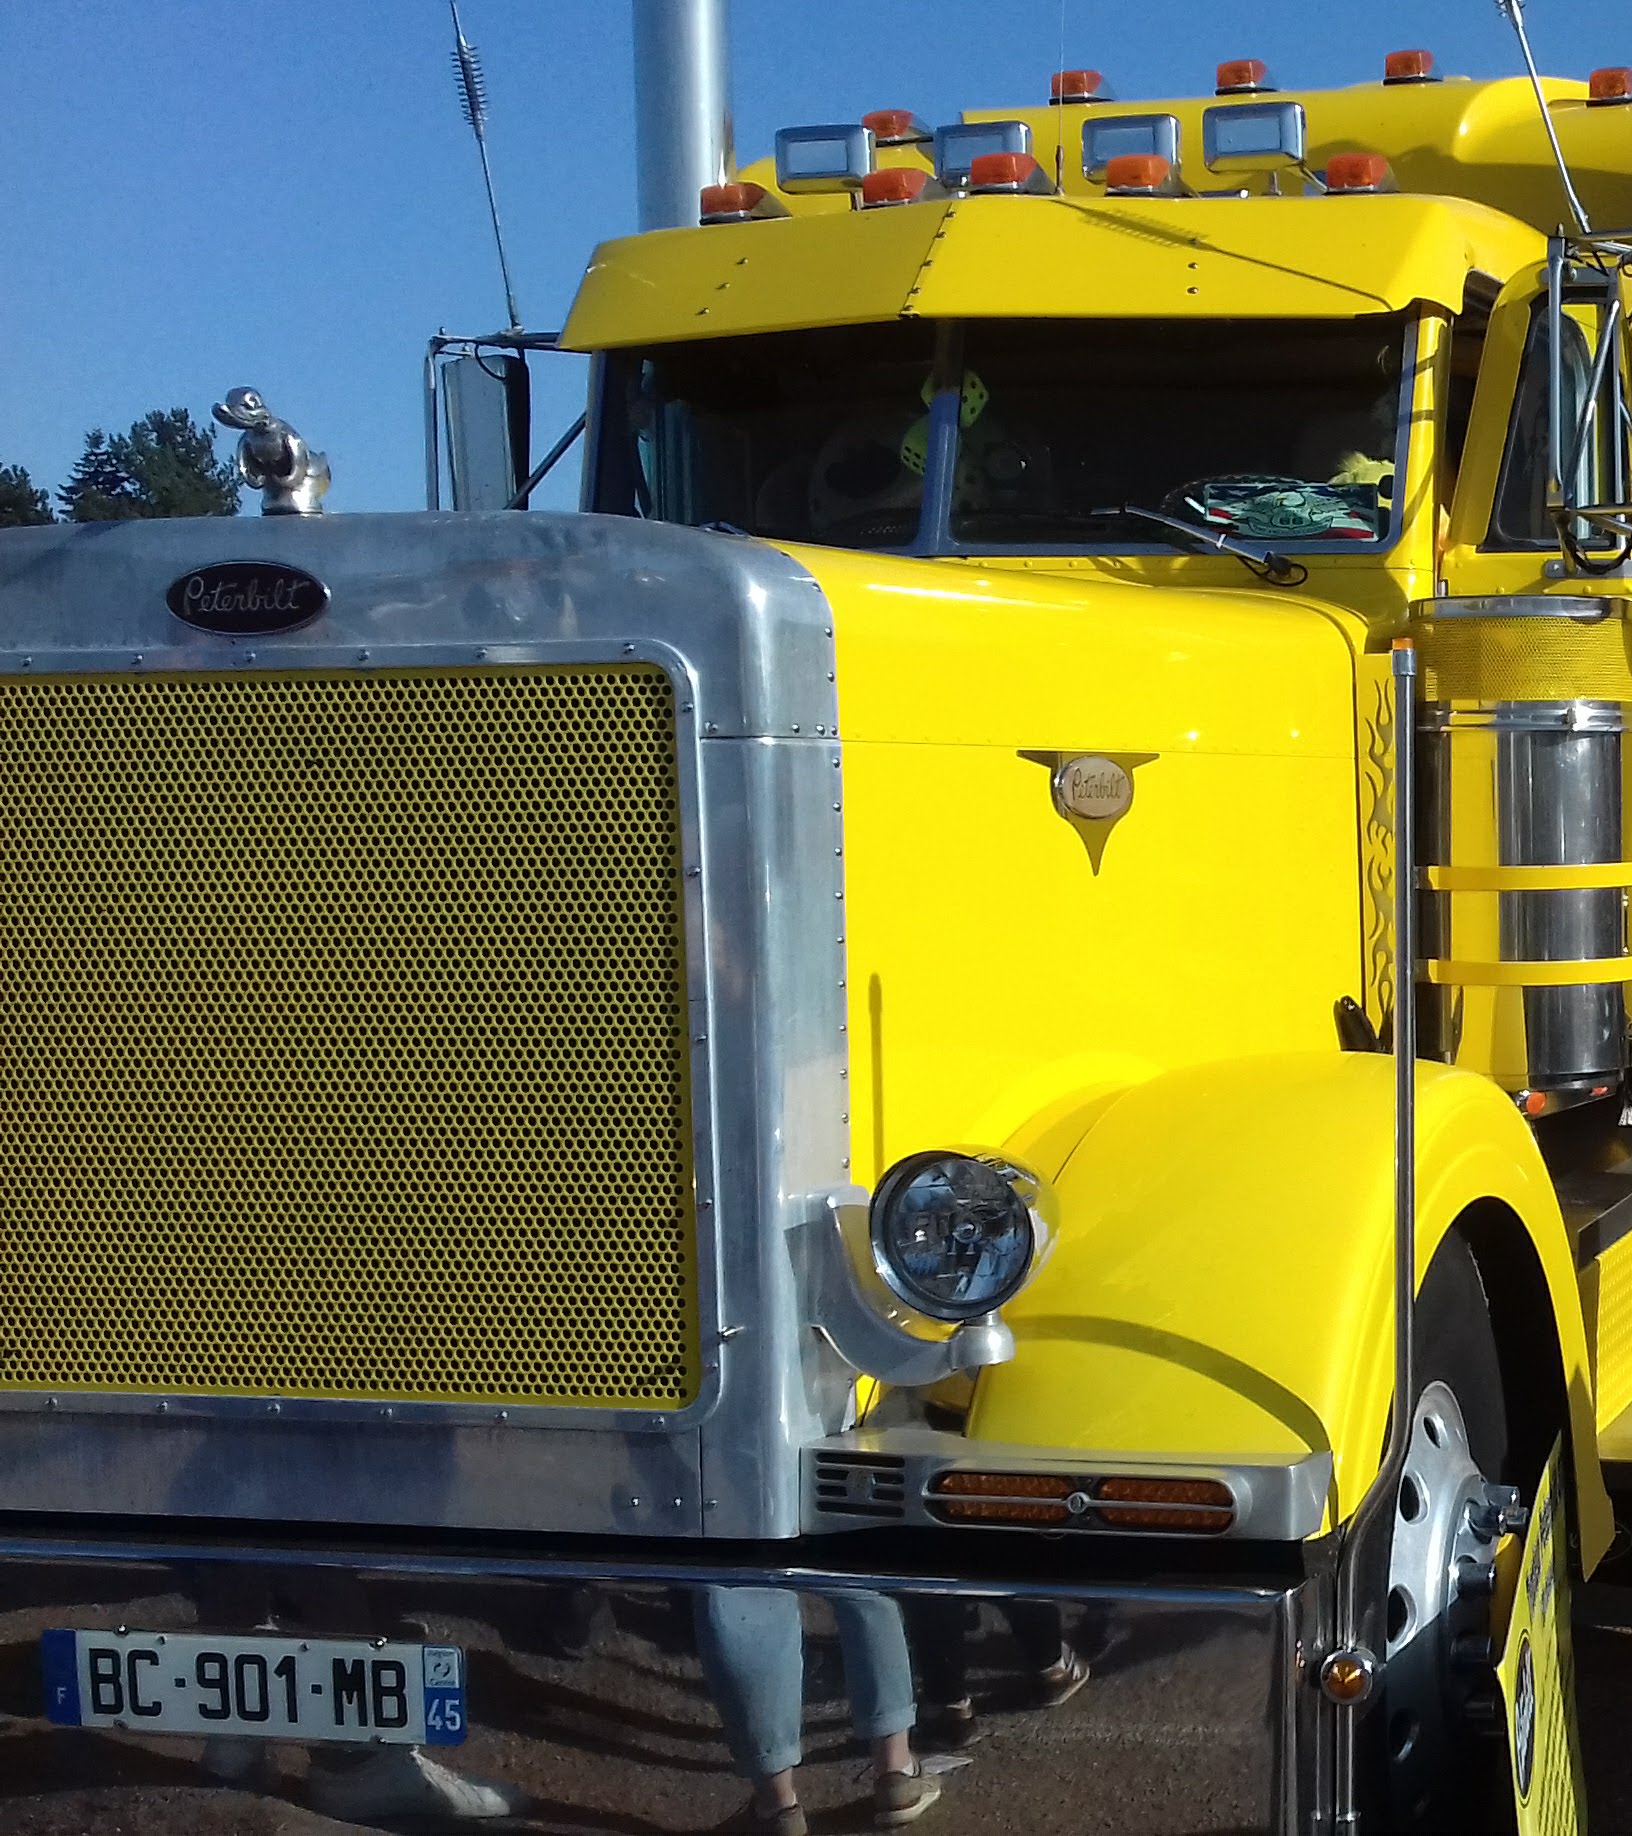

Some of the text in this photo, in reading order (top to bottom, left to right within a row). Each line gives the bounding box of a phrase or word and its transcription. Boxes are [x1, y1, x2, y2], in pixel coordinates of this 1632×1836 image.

[183, 576, 310, 616] Peterbilt
[1071, 767, 1125, 801] Peterbilt
[56, 1686, 67, 1705] F
[427, 1699, 461, 1731] 45
